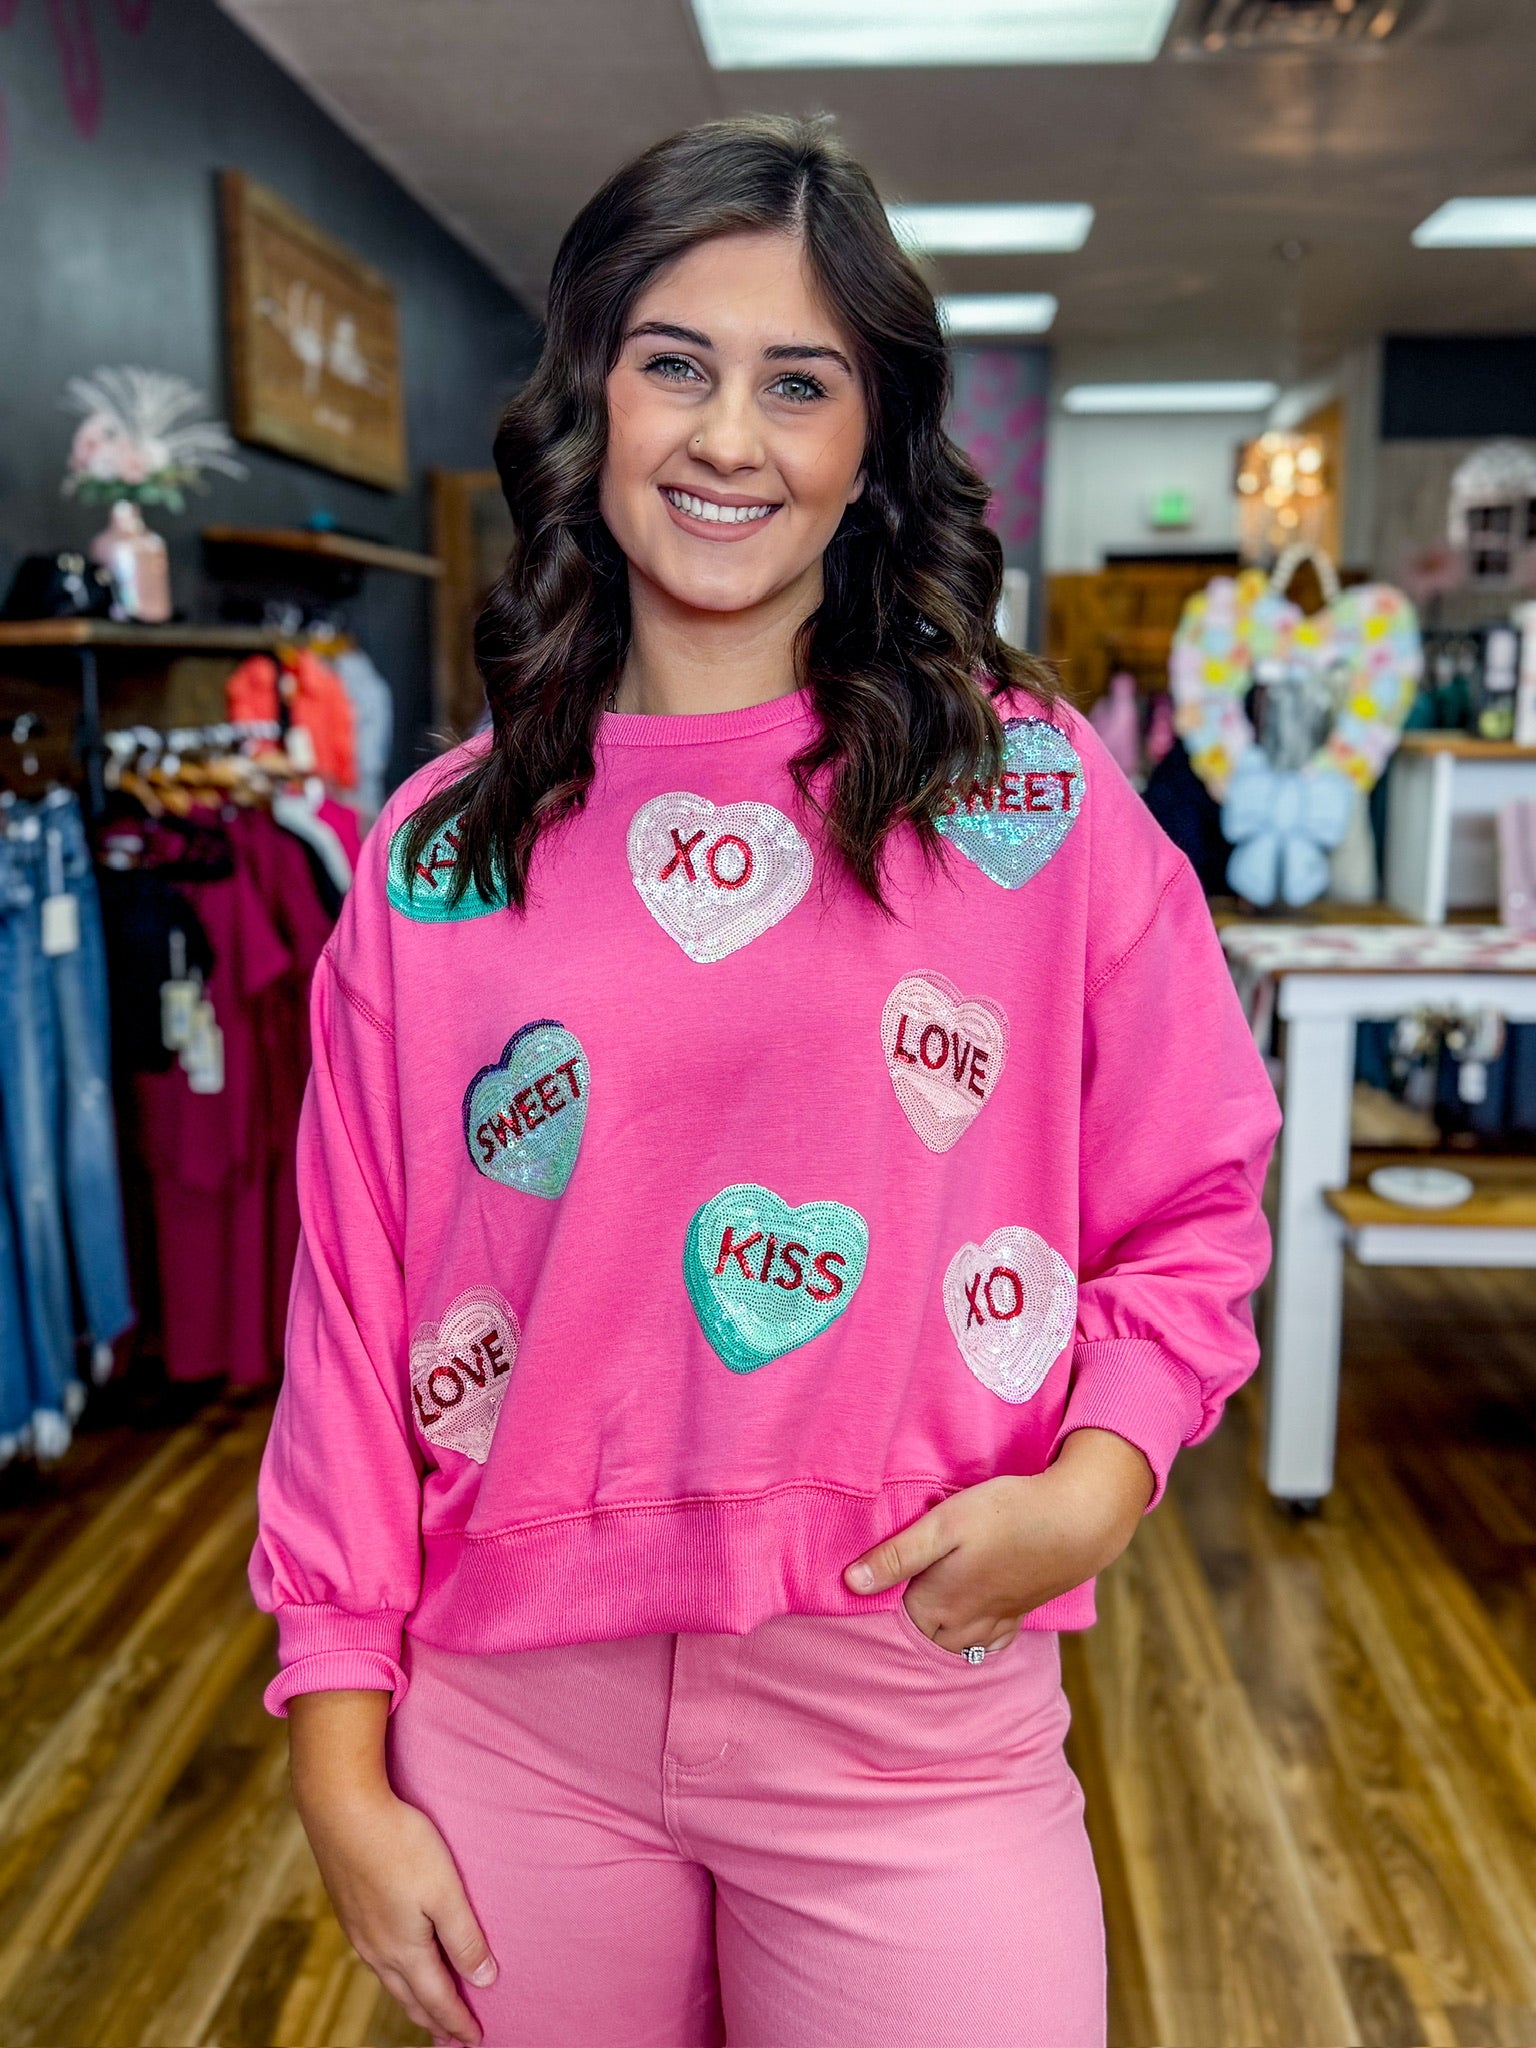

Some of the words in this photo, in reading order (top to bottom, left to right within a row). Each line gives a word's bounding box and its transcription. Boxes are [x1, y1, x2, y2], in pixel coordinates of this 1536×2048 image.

[658, 827, 753, 891] XO
[893, 1014, 989, 1099] LOVE
[476, 1057, 583, 1164] SWEET
[714, 1226, 847, 1303] KISS
[965, 1266, 1024, 1331] XO
[413, 1329, 511, 1428] LOVE
